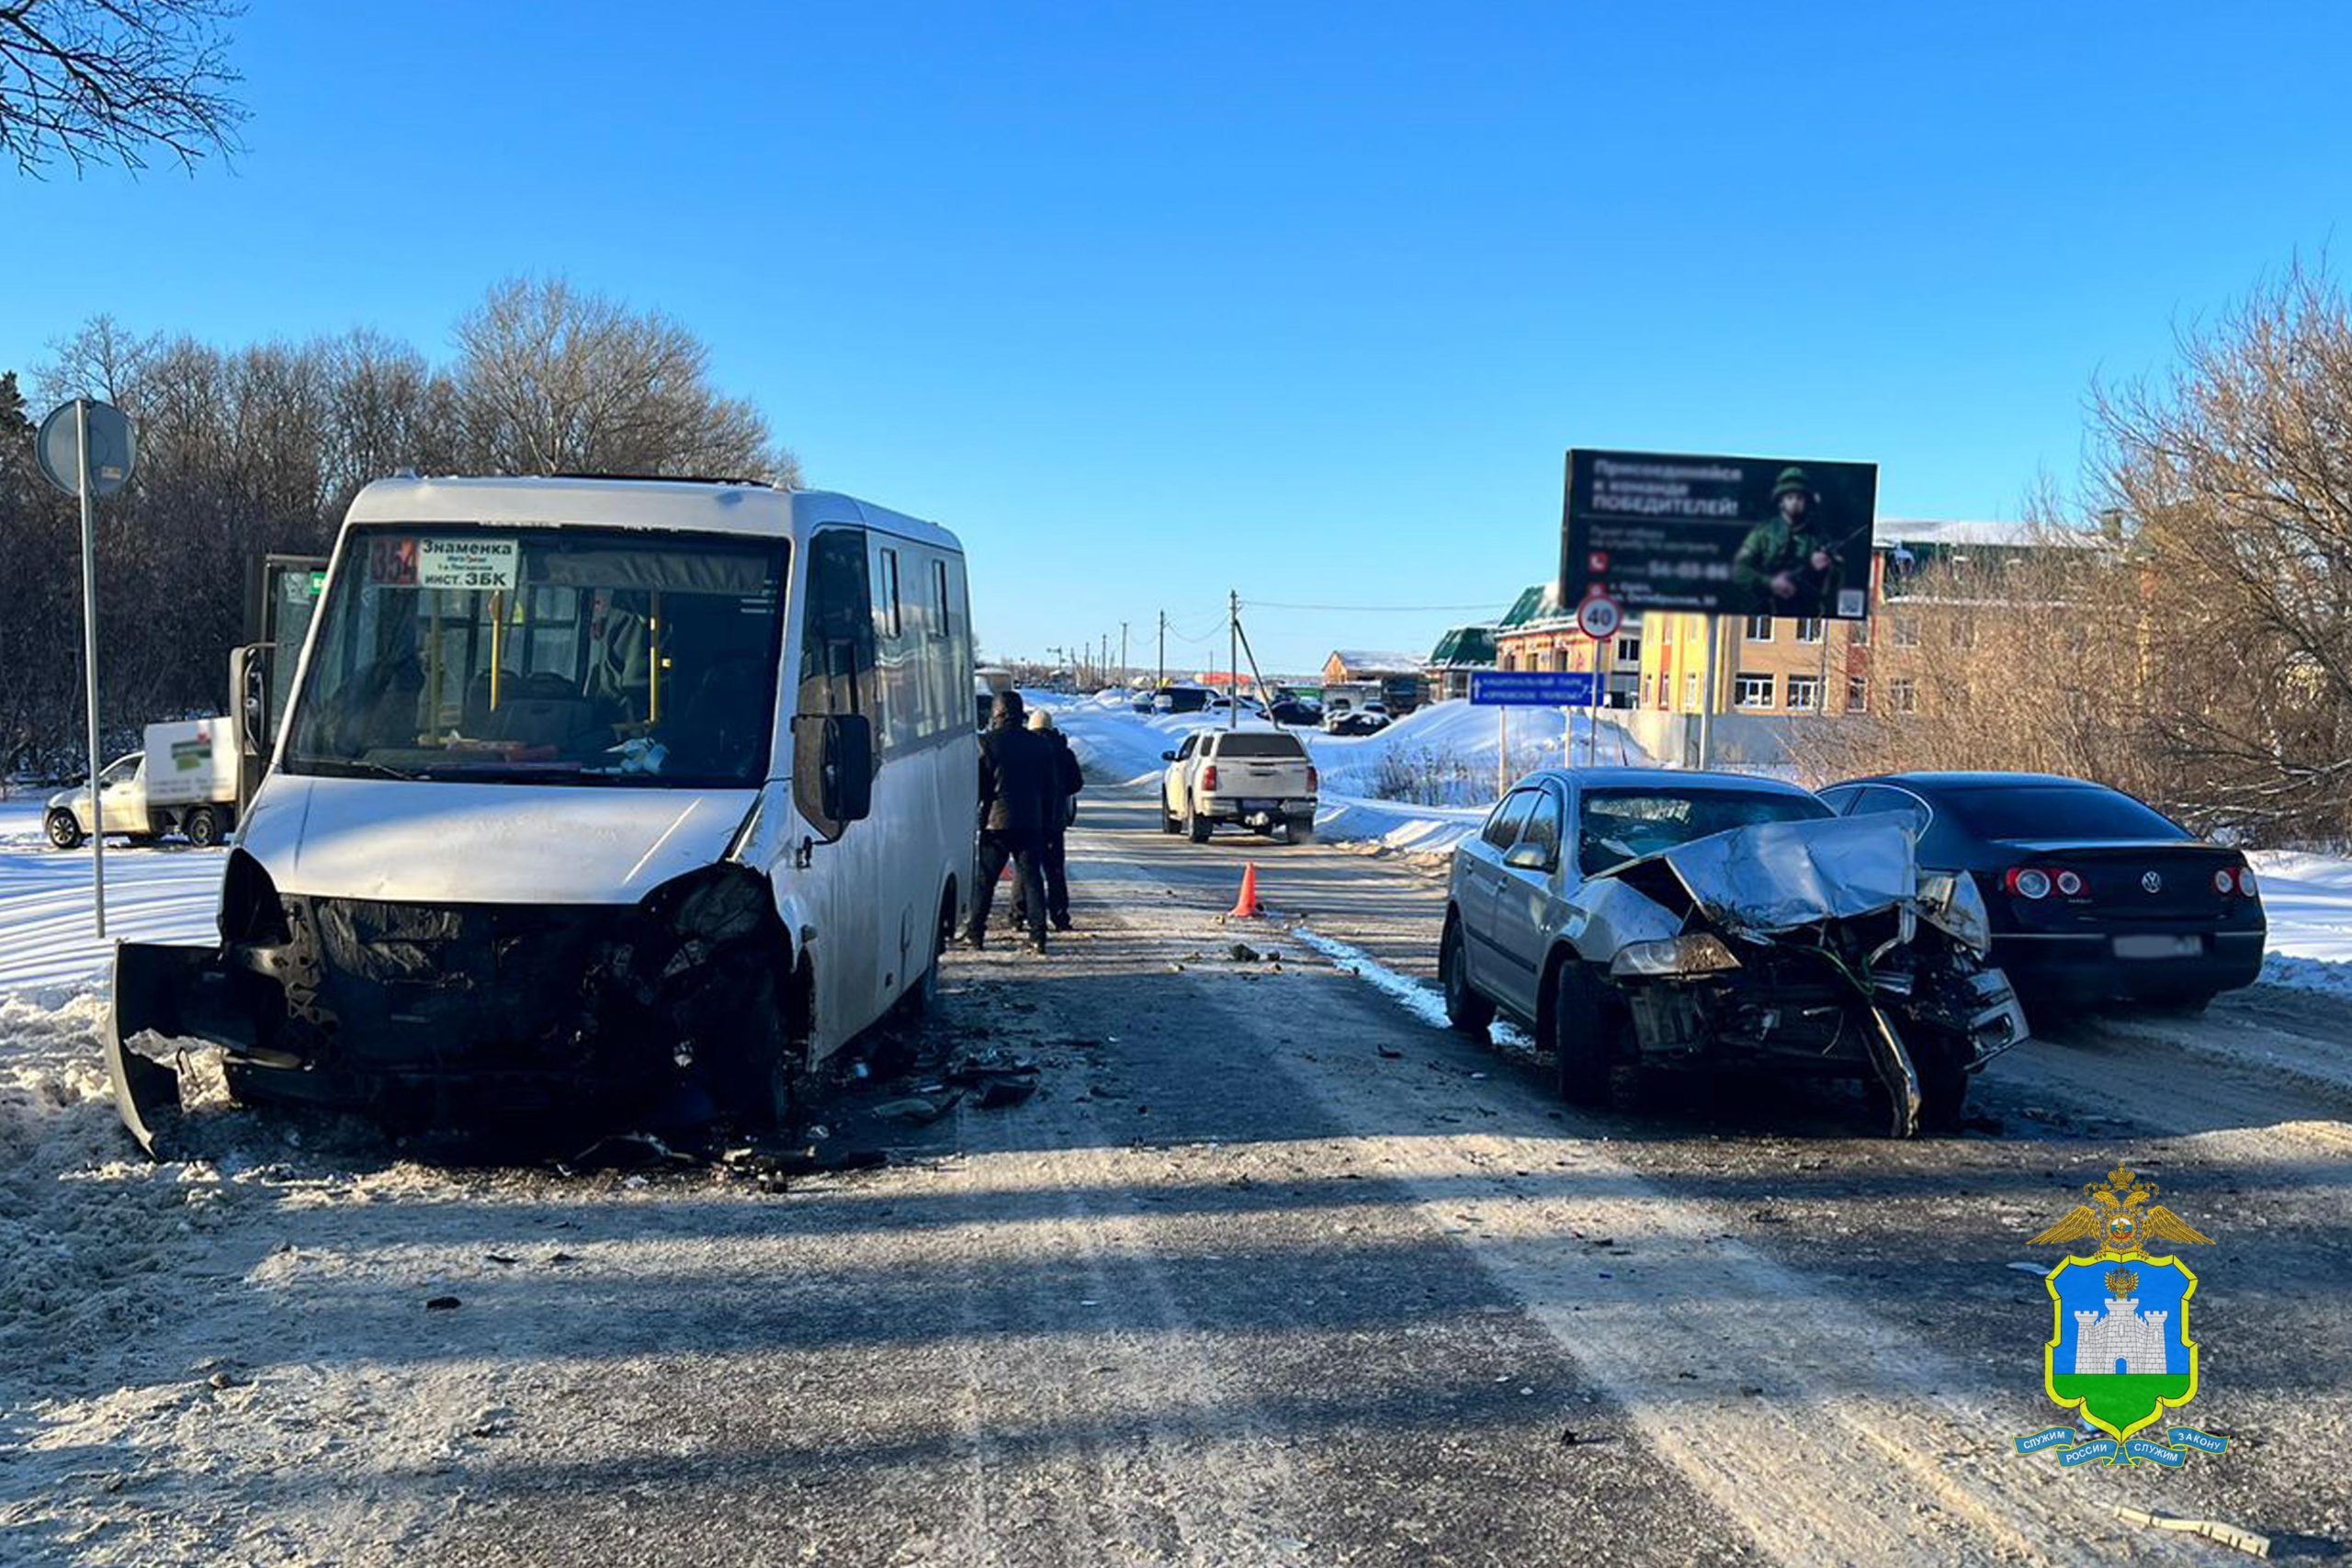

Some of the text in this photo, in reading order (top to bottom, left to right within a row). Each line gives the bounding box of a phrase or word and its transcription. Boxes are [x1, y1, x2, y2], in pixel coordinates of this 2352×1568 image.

[1591, 495, 1739, 517] ПОБЕДИТЕЛЕЙ!
[423, 539, 513, 555] Знаменка
[424, 574, 463, 586] инст.
[1587, 608, 1612, 627] 40
